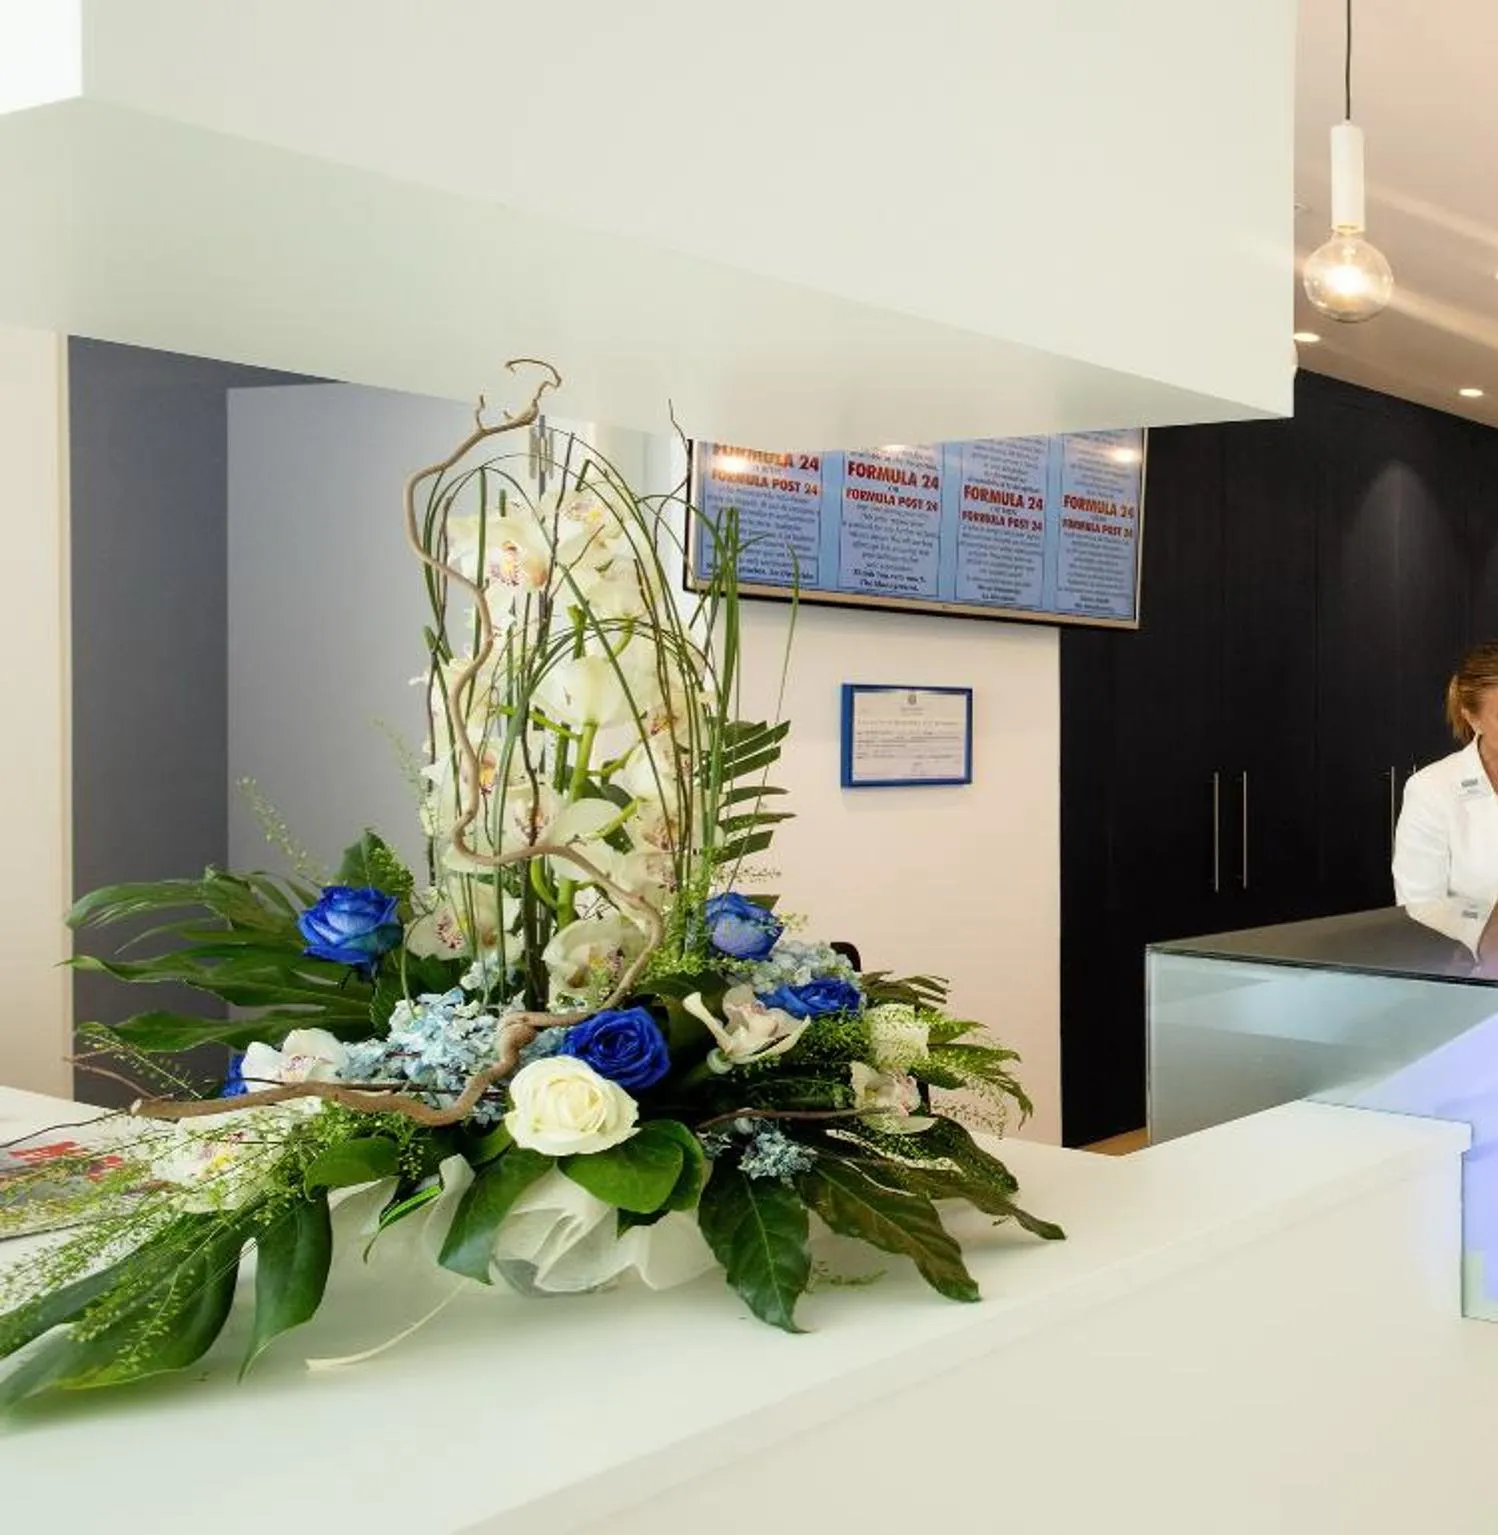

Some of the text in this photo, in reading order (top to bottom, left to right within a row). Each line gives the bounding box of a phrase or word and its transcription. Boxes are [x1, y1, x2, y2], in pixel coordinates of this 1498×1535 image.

[799, 454, 820, 471] 24
[847, 460, 940, 490] FORMULA 24
[772, 478, 801, 493] POST
[804, 482, 819, 496] 24
[846, 487, 939, 512] FORMULA POST 24
[963, 485, 1025, 509] FORMULA
[1028, 496, 1044, 512] 24
[962, 510, 1005, 526] FORMULA
[1063, 494, 1136, 519] FORMULA 24
